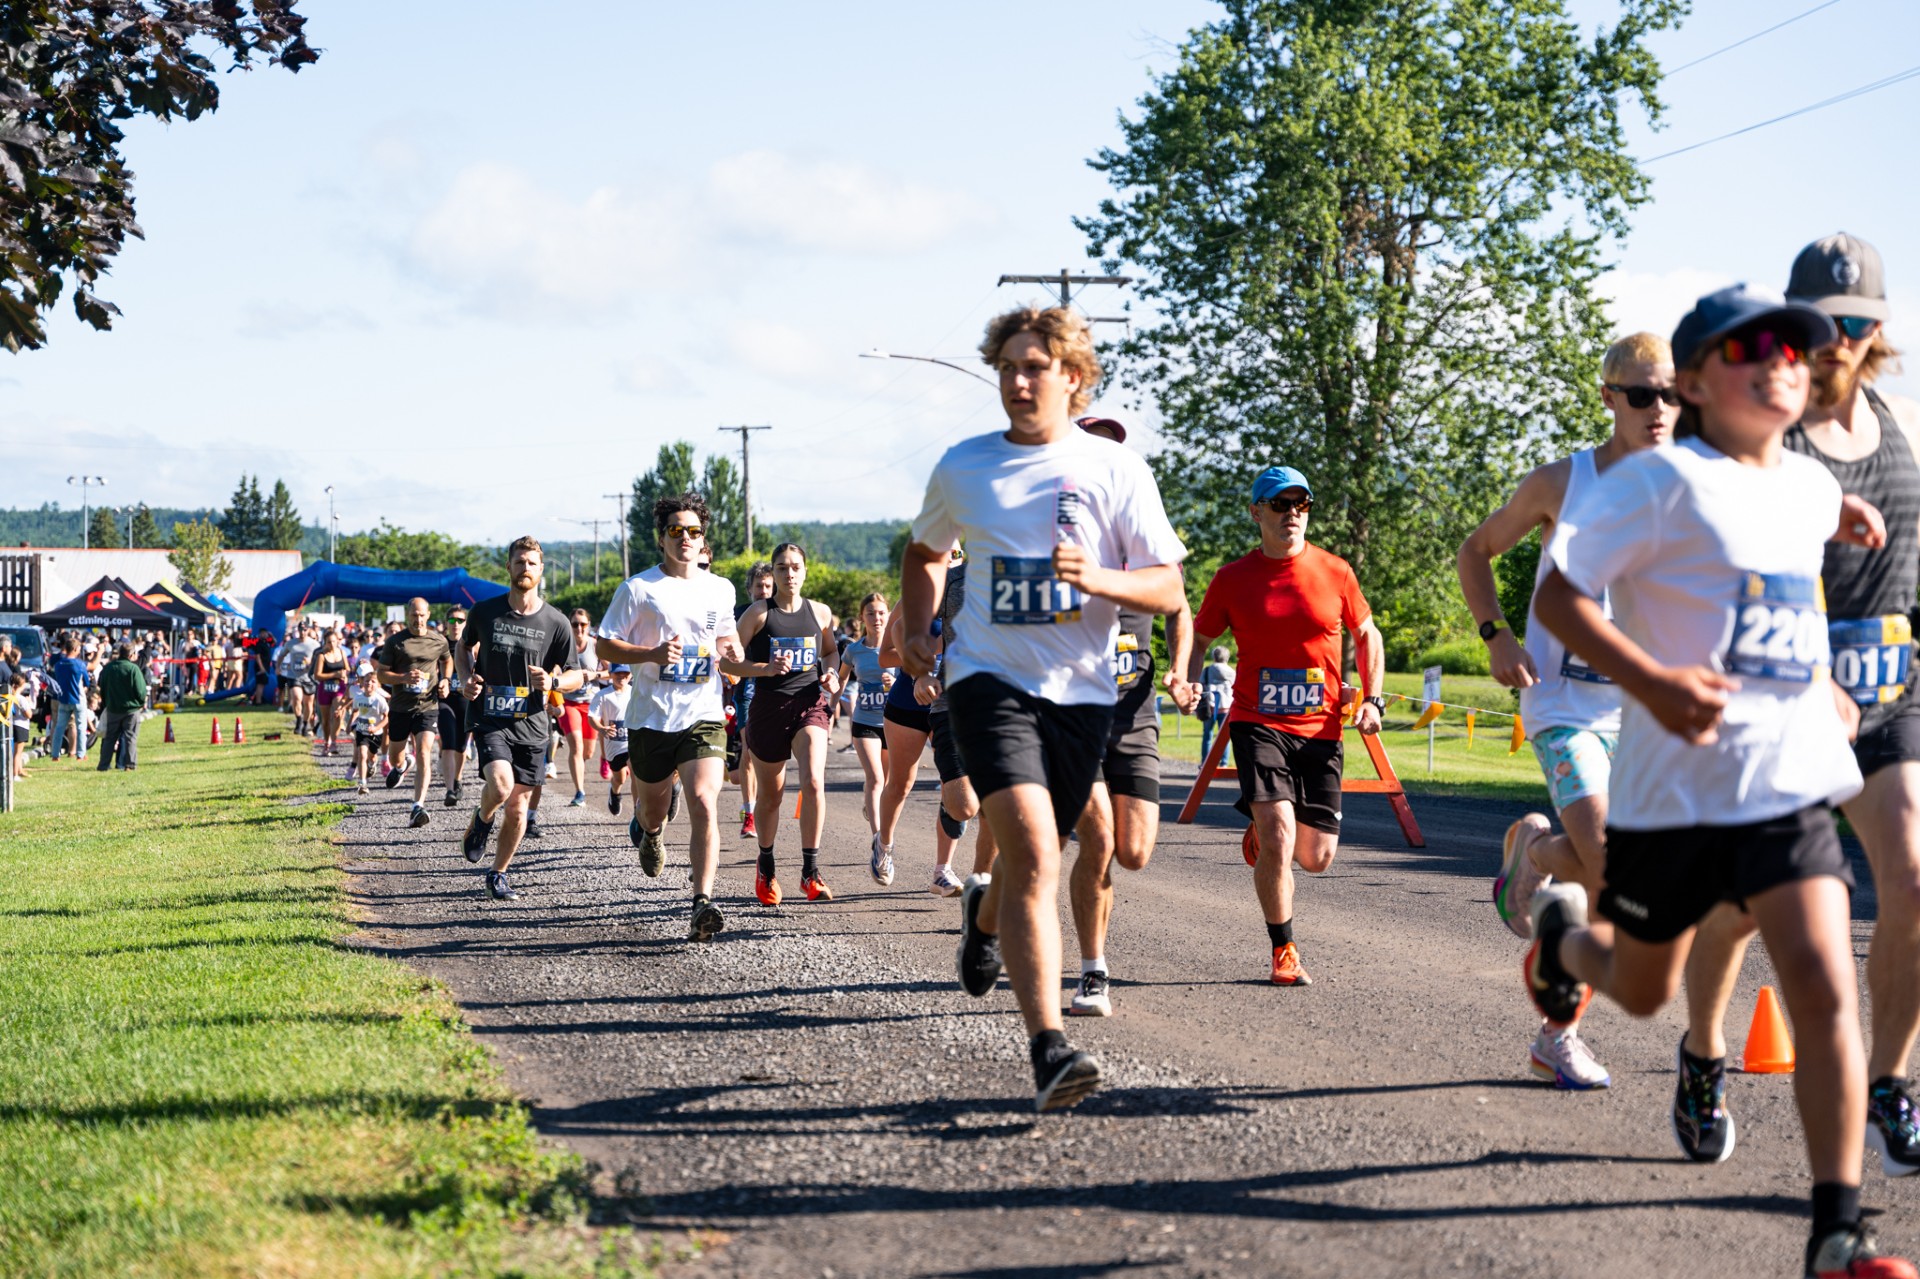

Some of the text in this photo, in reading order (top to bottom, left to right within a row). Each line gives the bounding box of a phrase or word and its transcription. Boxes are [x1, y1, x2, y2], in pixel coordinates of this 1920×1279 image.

[1057, 491, 1079, 525] RUN
[85, 590, 120, 611] CS
[995, 580, 1071, 612] 2111
[68, 615, 132, 627] cstiming.com
[494, 622, 546, 639] UNDER
[706, 611, 717, 630] RUN
[663, 657, 708, 676] 2172
[1833, 645, 1900, 687] 011
[488, 695, 526, 712] 1947
[1262, 684, 1320, 706] 2104
